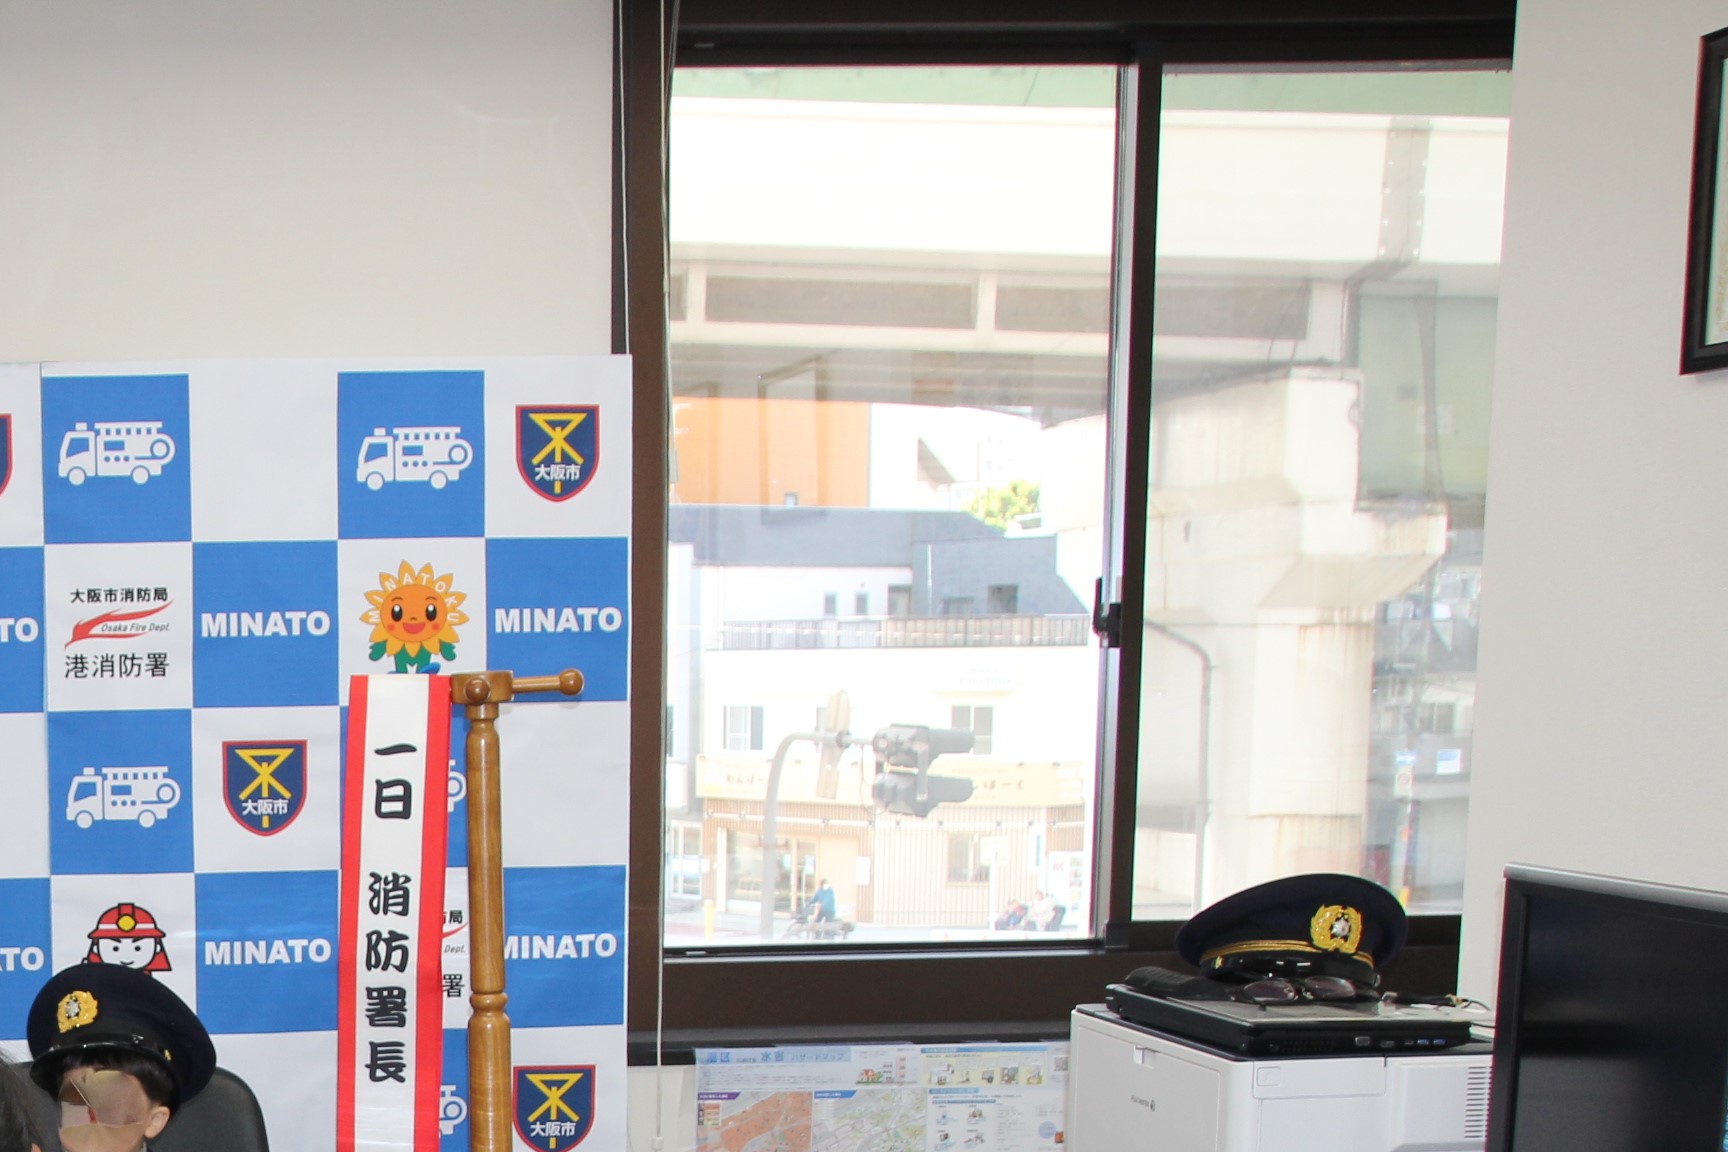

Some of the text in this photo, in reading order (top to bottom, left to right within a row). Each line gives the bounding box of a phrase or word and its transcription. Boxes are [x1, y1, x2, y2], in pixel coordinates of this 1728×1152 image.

[534, 463, 581, 481] 大阪市
[70, 586, 169, 604] 大阪市消防局
[101, 624, 127, 635] Osaka
[129, 623, 147, 634] Fire
[201, 611, 331, 638] MINATO
[494, 606, 622, 634] MINATO
[64, 652, 170, 680] 港消防署
[241, 798, 288, 816] 大阪市
[204, 938, 332, 965] MINATO
[530, 1121, 576, 1138] 大阪市
